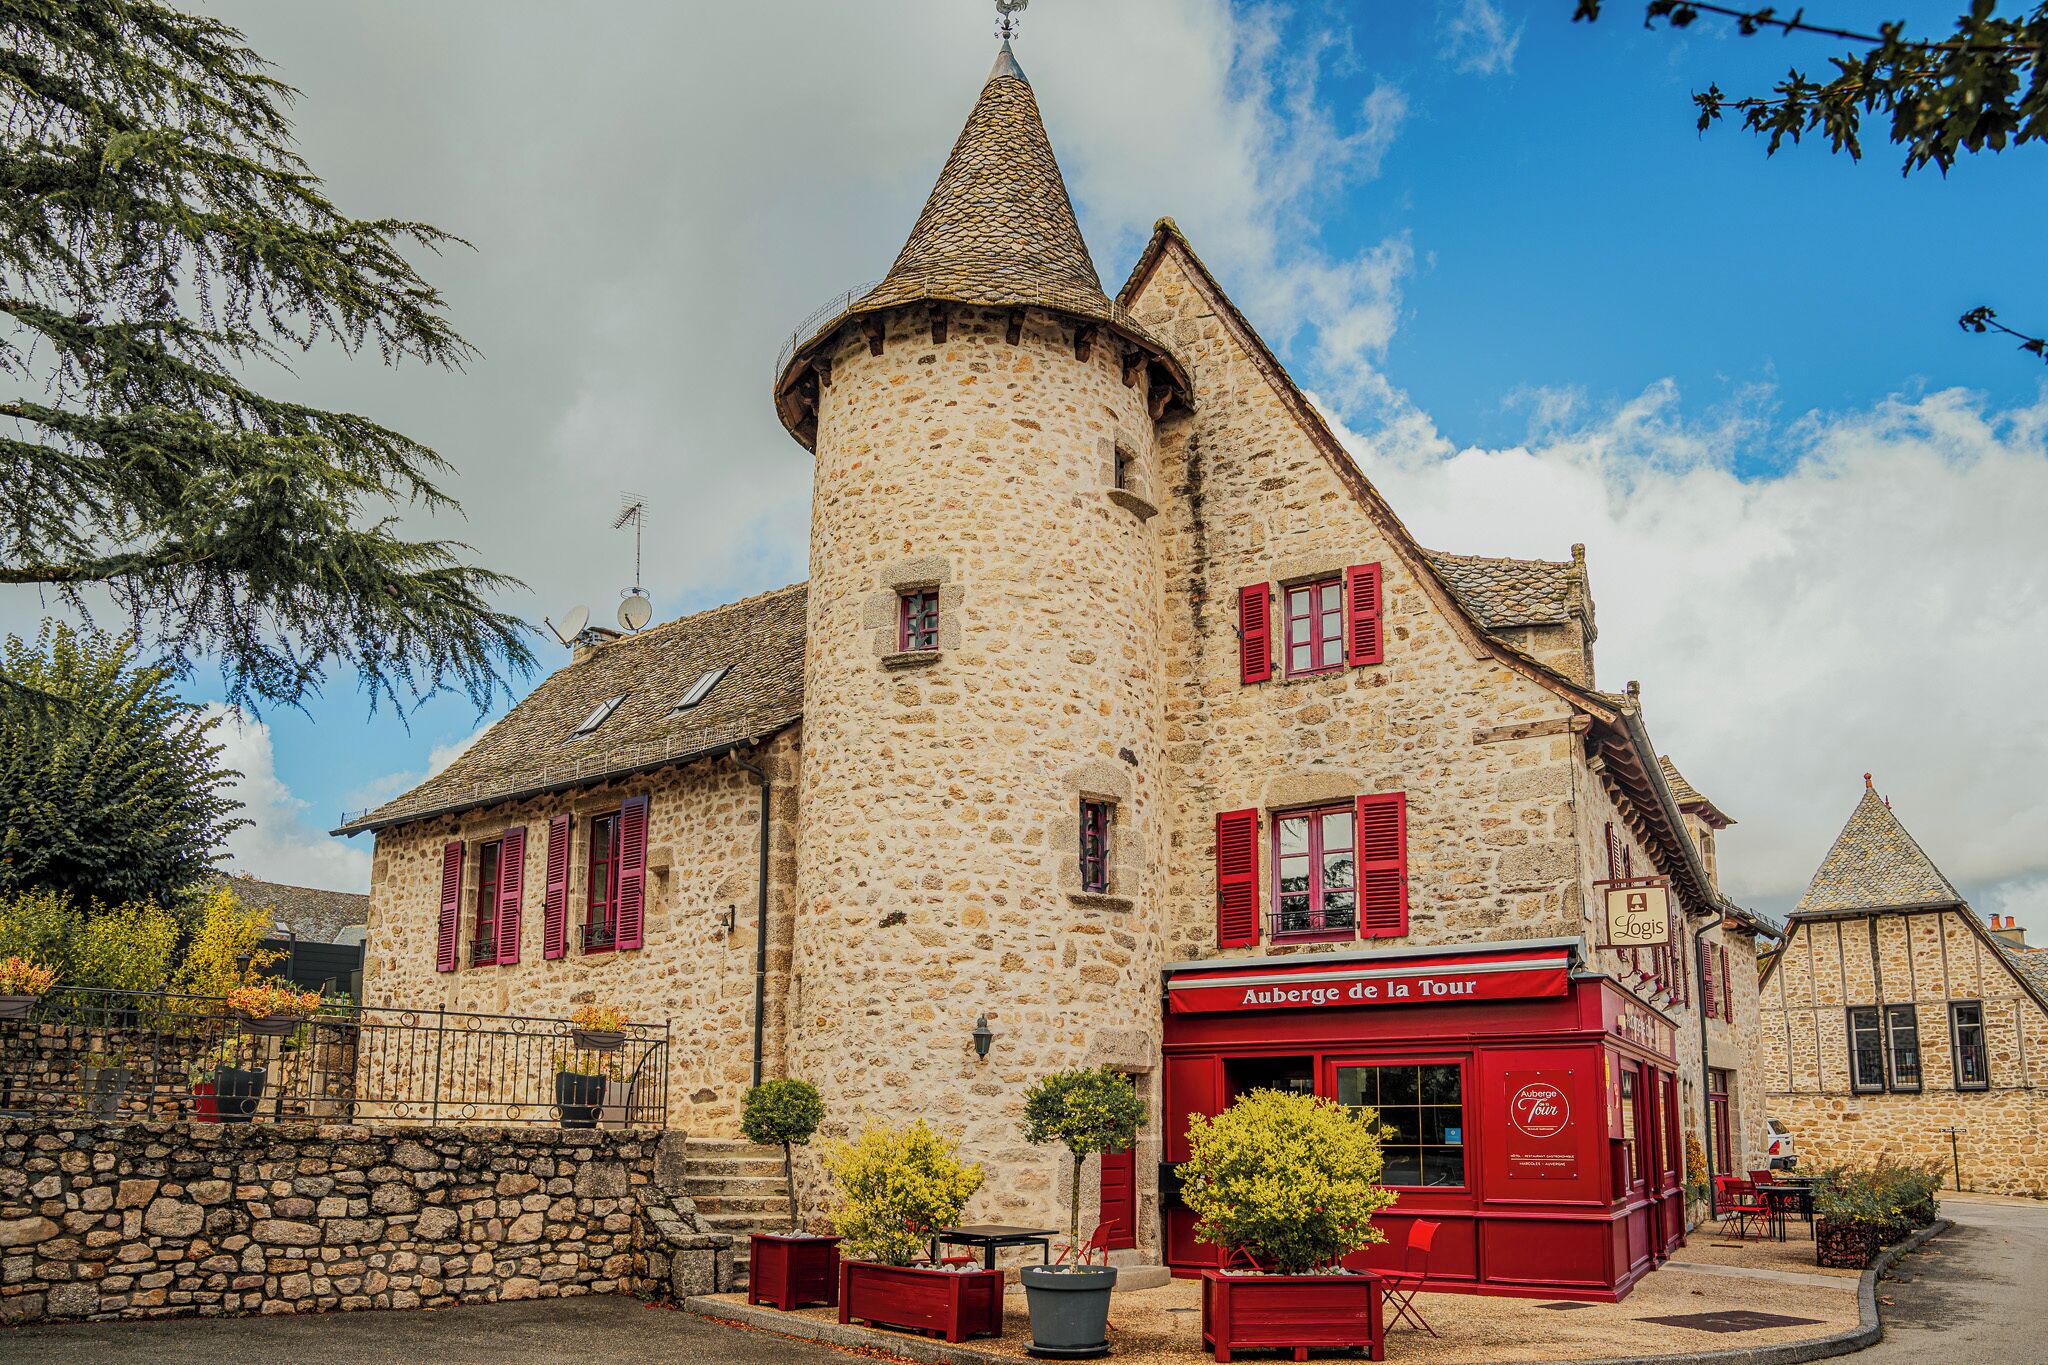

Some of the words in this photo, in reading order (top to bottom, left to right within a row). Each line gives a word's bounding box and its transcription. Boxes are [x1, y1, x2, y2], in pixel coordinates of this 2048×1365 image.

[1614, 914, 1664, 940] Logis
[1242, 987, 1340, 1005] Auberge
[1348, 983, 1378, 999] de
[1387, 981, 1409, 997] la
[1418, 979, 1477, 996] Tour
[1520, 1090, 1557, 1099] Auberge
[1517, 1098, 1558, 1123] Tour
